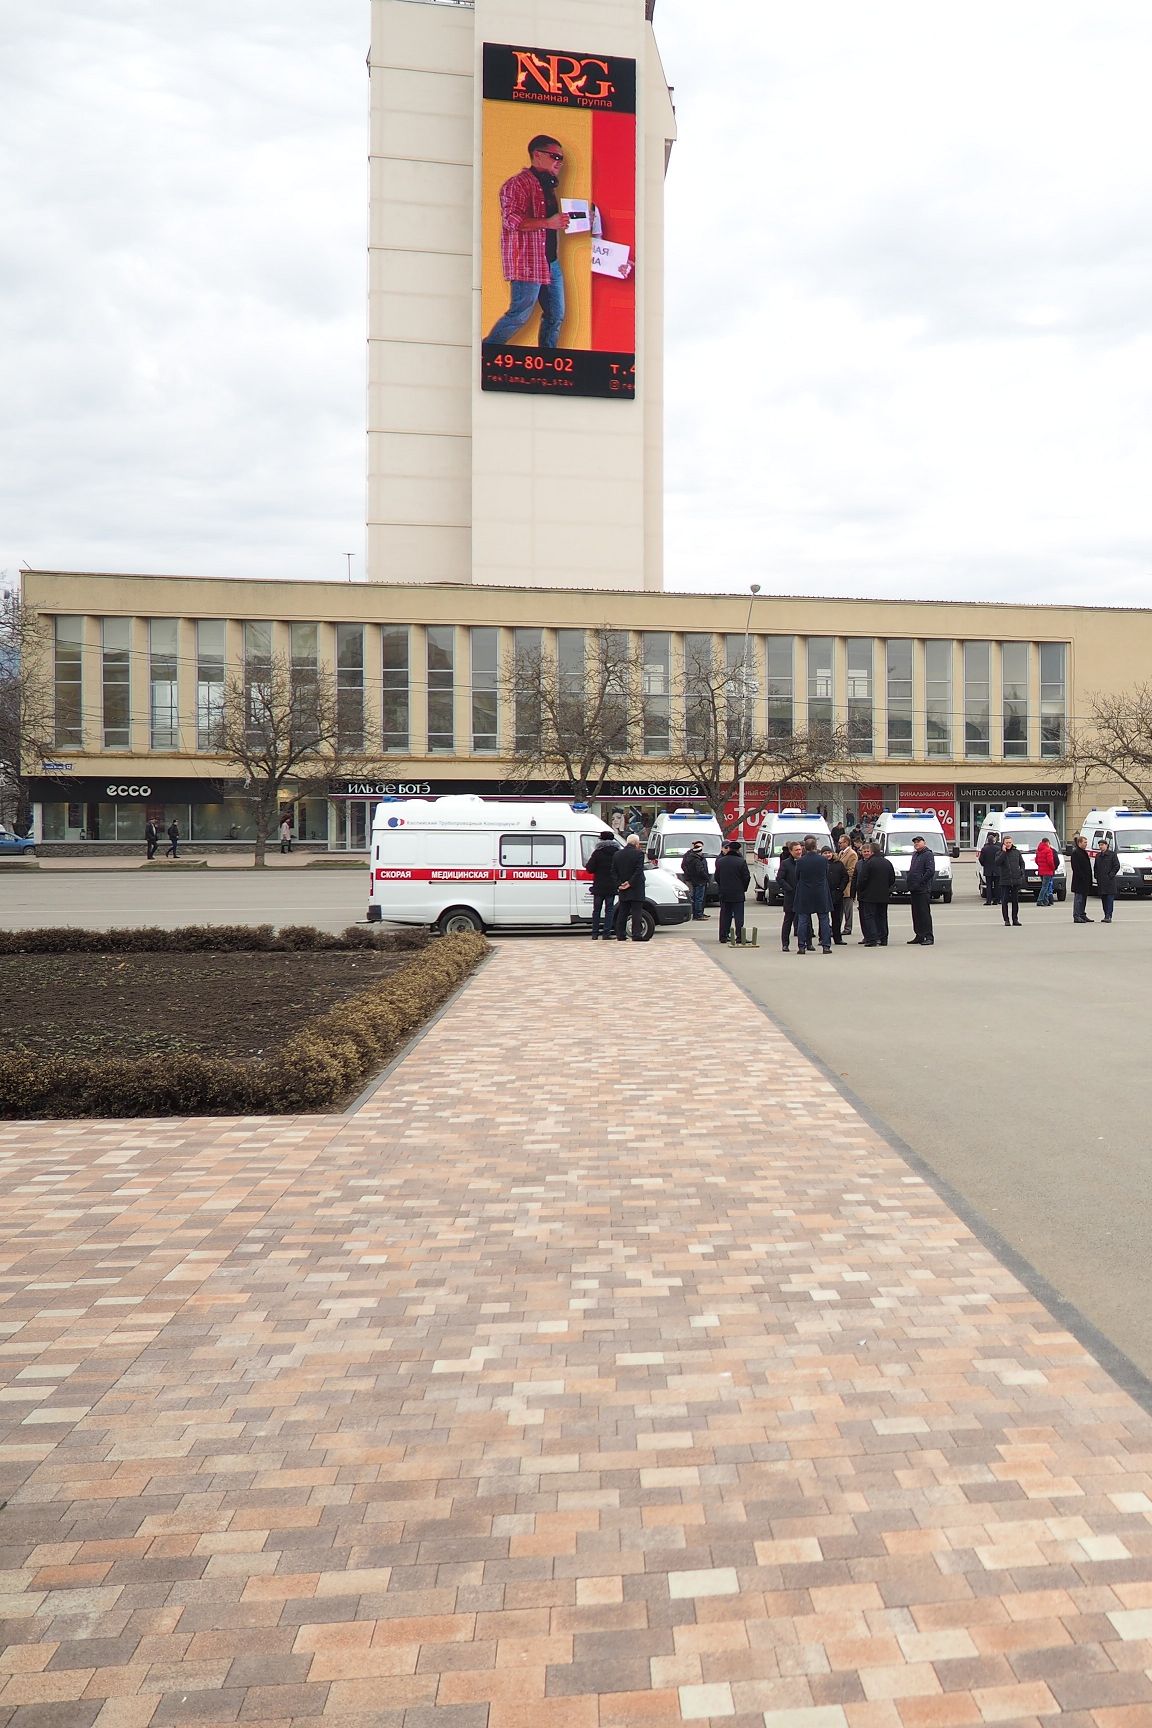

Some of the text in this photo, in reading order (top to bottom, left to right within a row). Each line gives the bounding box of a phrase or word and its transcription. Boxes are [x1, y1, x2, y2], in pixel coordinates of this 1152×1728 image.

[512, 51, 615, 98] NRG
[512, 91, 613, 107] рекламная группа
[106, 785, 151, 796] ecco
[431, 871, 489, 879] МЕДИЦИНСКАЯ
[513, 871, 548, 879] ПОМОЩЬ
